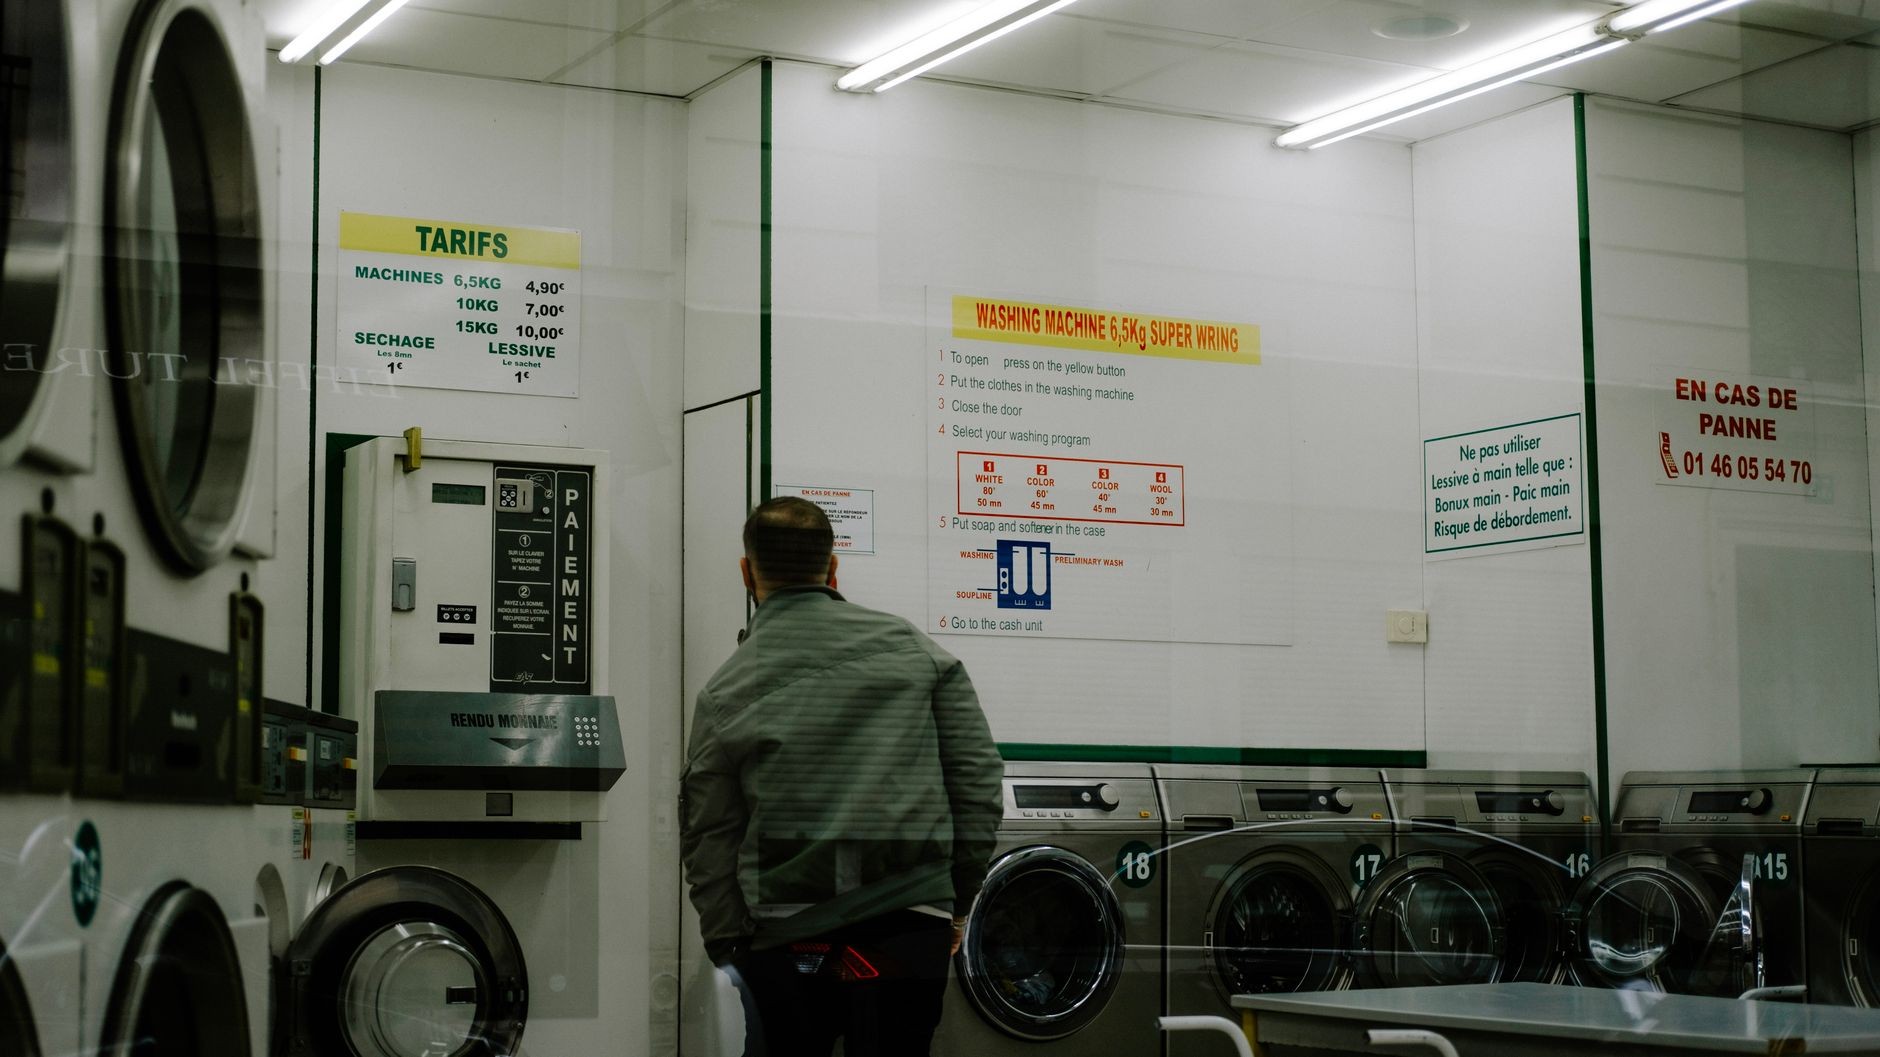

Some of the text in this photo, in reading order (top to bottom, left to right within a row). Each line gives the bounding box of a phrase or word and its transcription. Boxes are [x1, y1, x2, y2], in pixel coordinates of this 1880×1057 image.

[415, 225, 508, 258] TARIFS
[355, 266, 564, 296] MACHINES 6,5KG 4,90€
[456, 298, 564, 318] 10KG 7,00€
[456, 320, 564, 340] 15KG 10,00€
[976, 302, 1239, 352] WASHING MACHINE 6,5Kg SUPER WRING
[354, 332, 434, 349] SECHAGE
[488, 342, 556, 358] LESSIVE
[388, 362, 402, 374] 1€
[514, 360, 541, 368] sachet
[939, 350, 1126, 377] 1 To open press on the yellow button
[515, 372, 530, 383] 1€
[938, 374, 1134, 400] 2 Put the clothes in the washing machine
[1676, 378, 1798, 410] EN CAS DE
[938, 398, 1022, 416] 3 Close the door
[938, 424, 1090, 448] 4 Select your washing program
[1700, 414, 1777, 441] PANNE
[1460, 434, 1541, 463] Ne pas utiliser
[986, 463, 992, 472] 1
[1040, 466, 1046, 474] 2
[1102, 470, 1107, 478] 3
[1432, 470, 1469, 490] Lessive
[1473, 468, 1480, 484] à
[1484, 463, 1512, 482] main
[1515, 457, 1539, 476] telle
[1543, 458, 1565, 477] que
[1684, 451, 1812, 485] 01 46 05 54 70
[976, 475, 1002, 484] WHITE
[1027, 478, 1054, 487] COLOR
[1092, 482, 1118, 490] COLOR
[1158, 474, 1164, 482] 4
[1150, 485, 1172, 494] WOOL
[1435, 497, 1470, 514] Bonux
[1473, 489, 1501, 508] main
[1513, 484, 1537, 502] Paic
[1540, 479, 1570, 498] main
[978, 498, 988, 507] 50
[1030, 502, 1040, 510] 45
[1093, 505, 1102, 513] 45
[1150, 508, 1160, 516] 30
[939, 516, 1106, 537] 5 Put soap and softener in the case
[1434, 505, 1572, 539] Risque de débordement.
[960, 551, 1124, 566] WASHING PRELIMINARY WASH
[562, 488, 579, 664] PAIEMENT
[521, 587, 528, 596] 2
[956, 591, 992, 600] SOUPLINE
[939, 616, 1043, 632] 6 Go to the cash unit
[451, 713, 558, 729] RENDU MONNAIE
[1122, 852, 1150, 880] 18
[1356, 854, 1381, 880] 17
[1566, 853, 1590, 879] 16
[1764, 852, 1788, 880] 15
